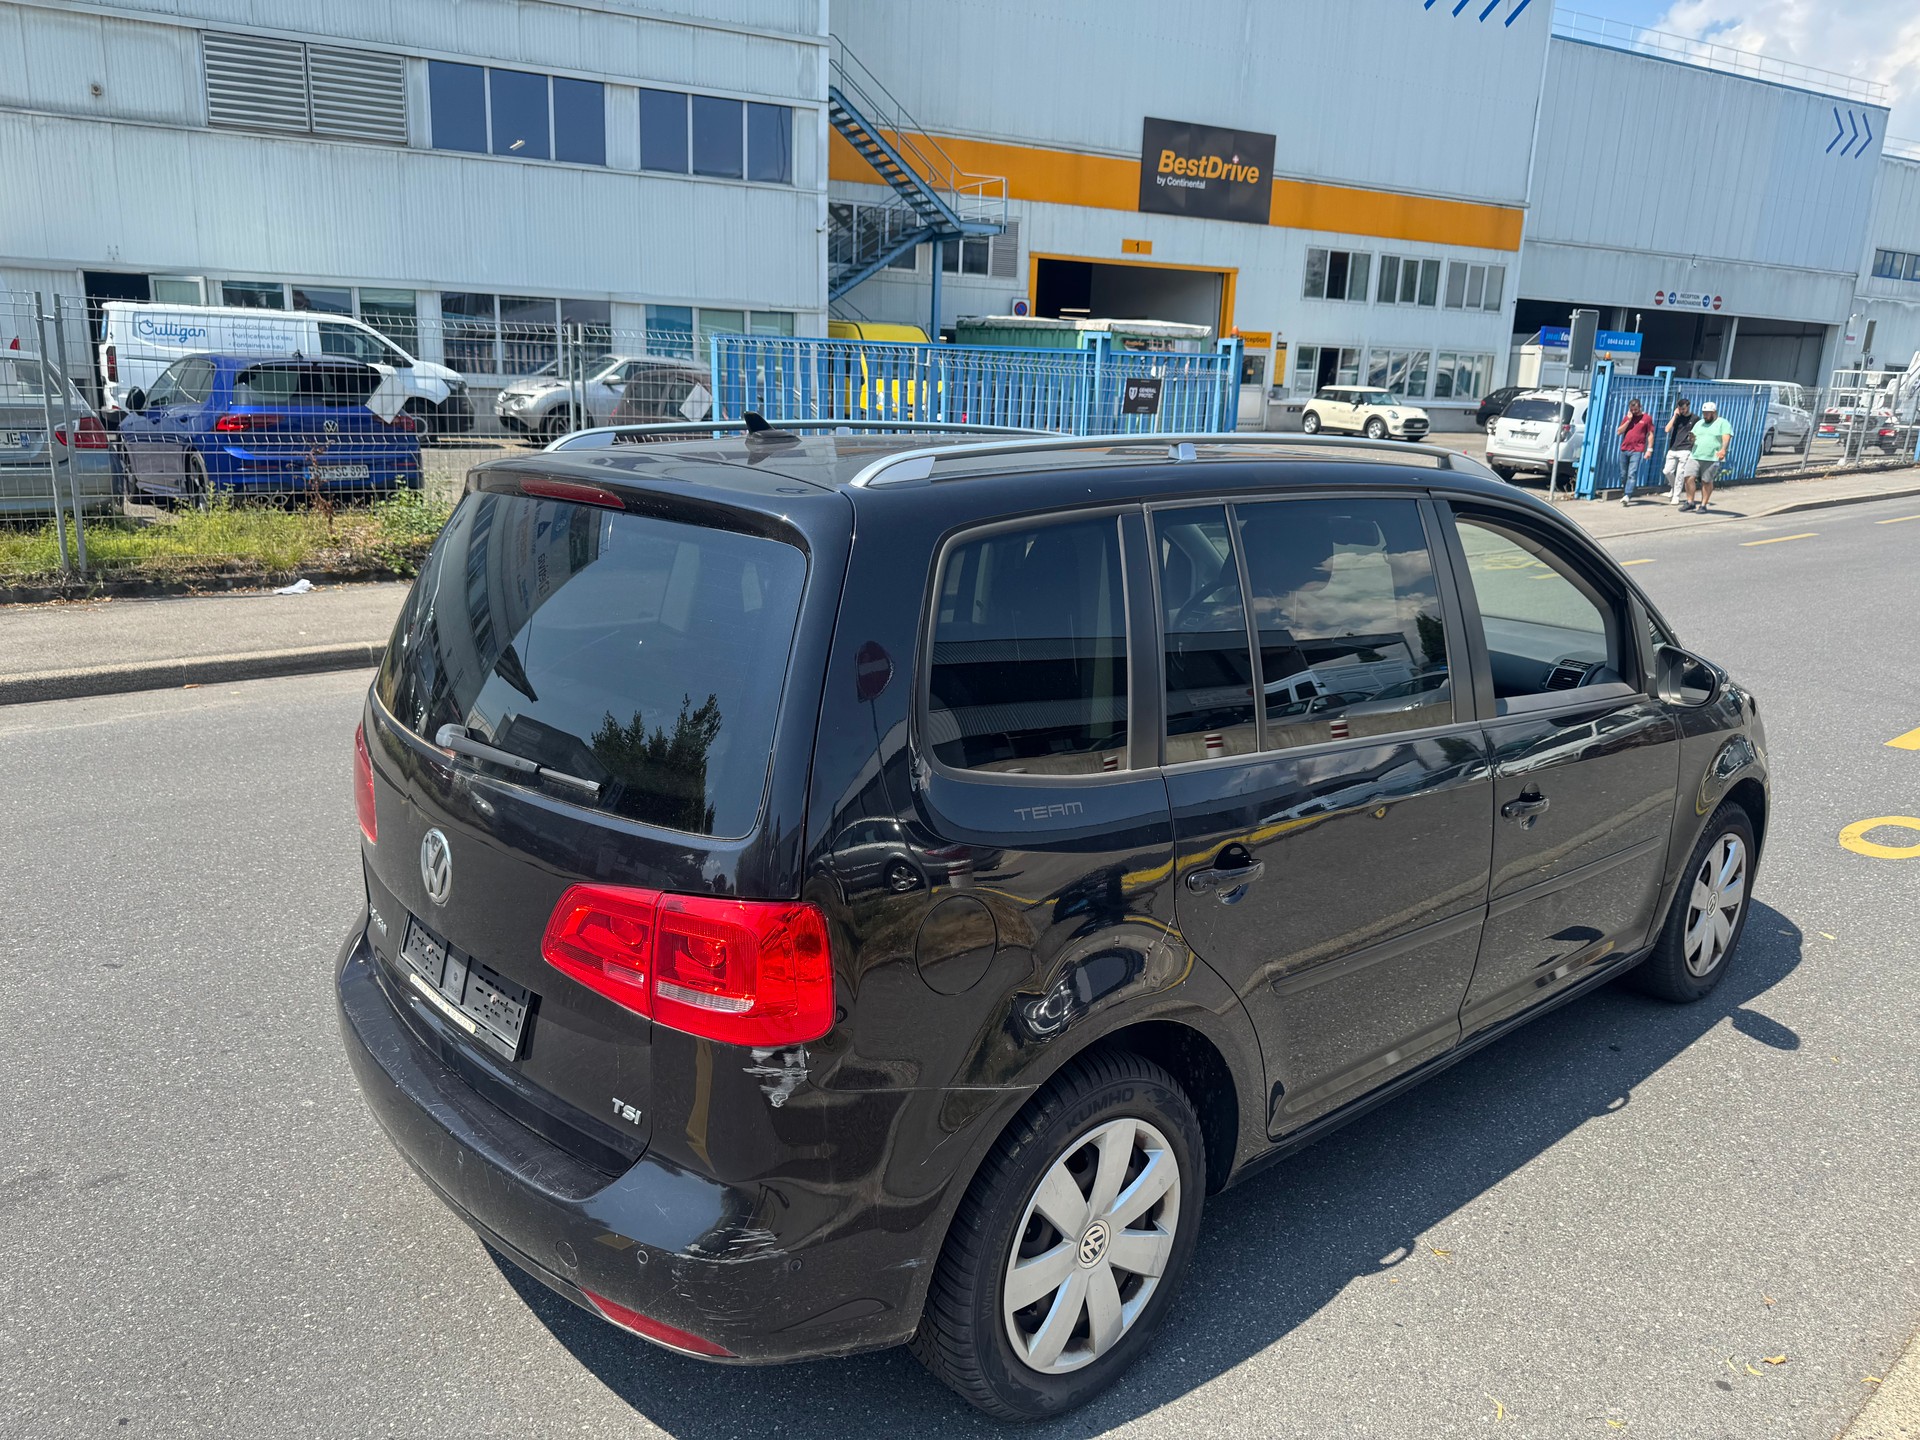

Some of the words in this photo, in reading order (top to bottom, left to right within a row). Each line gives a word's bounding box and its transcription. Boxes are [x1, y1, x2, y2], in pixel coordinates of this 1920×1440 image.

[1157, 149, 1260, 184] BestDrive
[1156, 175, 1166, 187] by
[1166, 176, 1206, 190] Continental
[1135, 241, 1140, 253] 1
[138, 319, 206, 343] Culligan
[1014, 802, 1083, 821] TEAM
[612, 1097, 642, 1125] TSI
[1065, 1087, 1135, 1133] KUMHO
